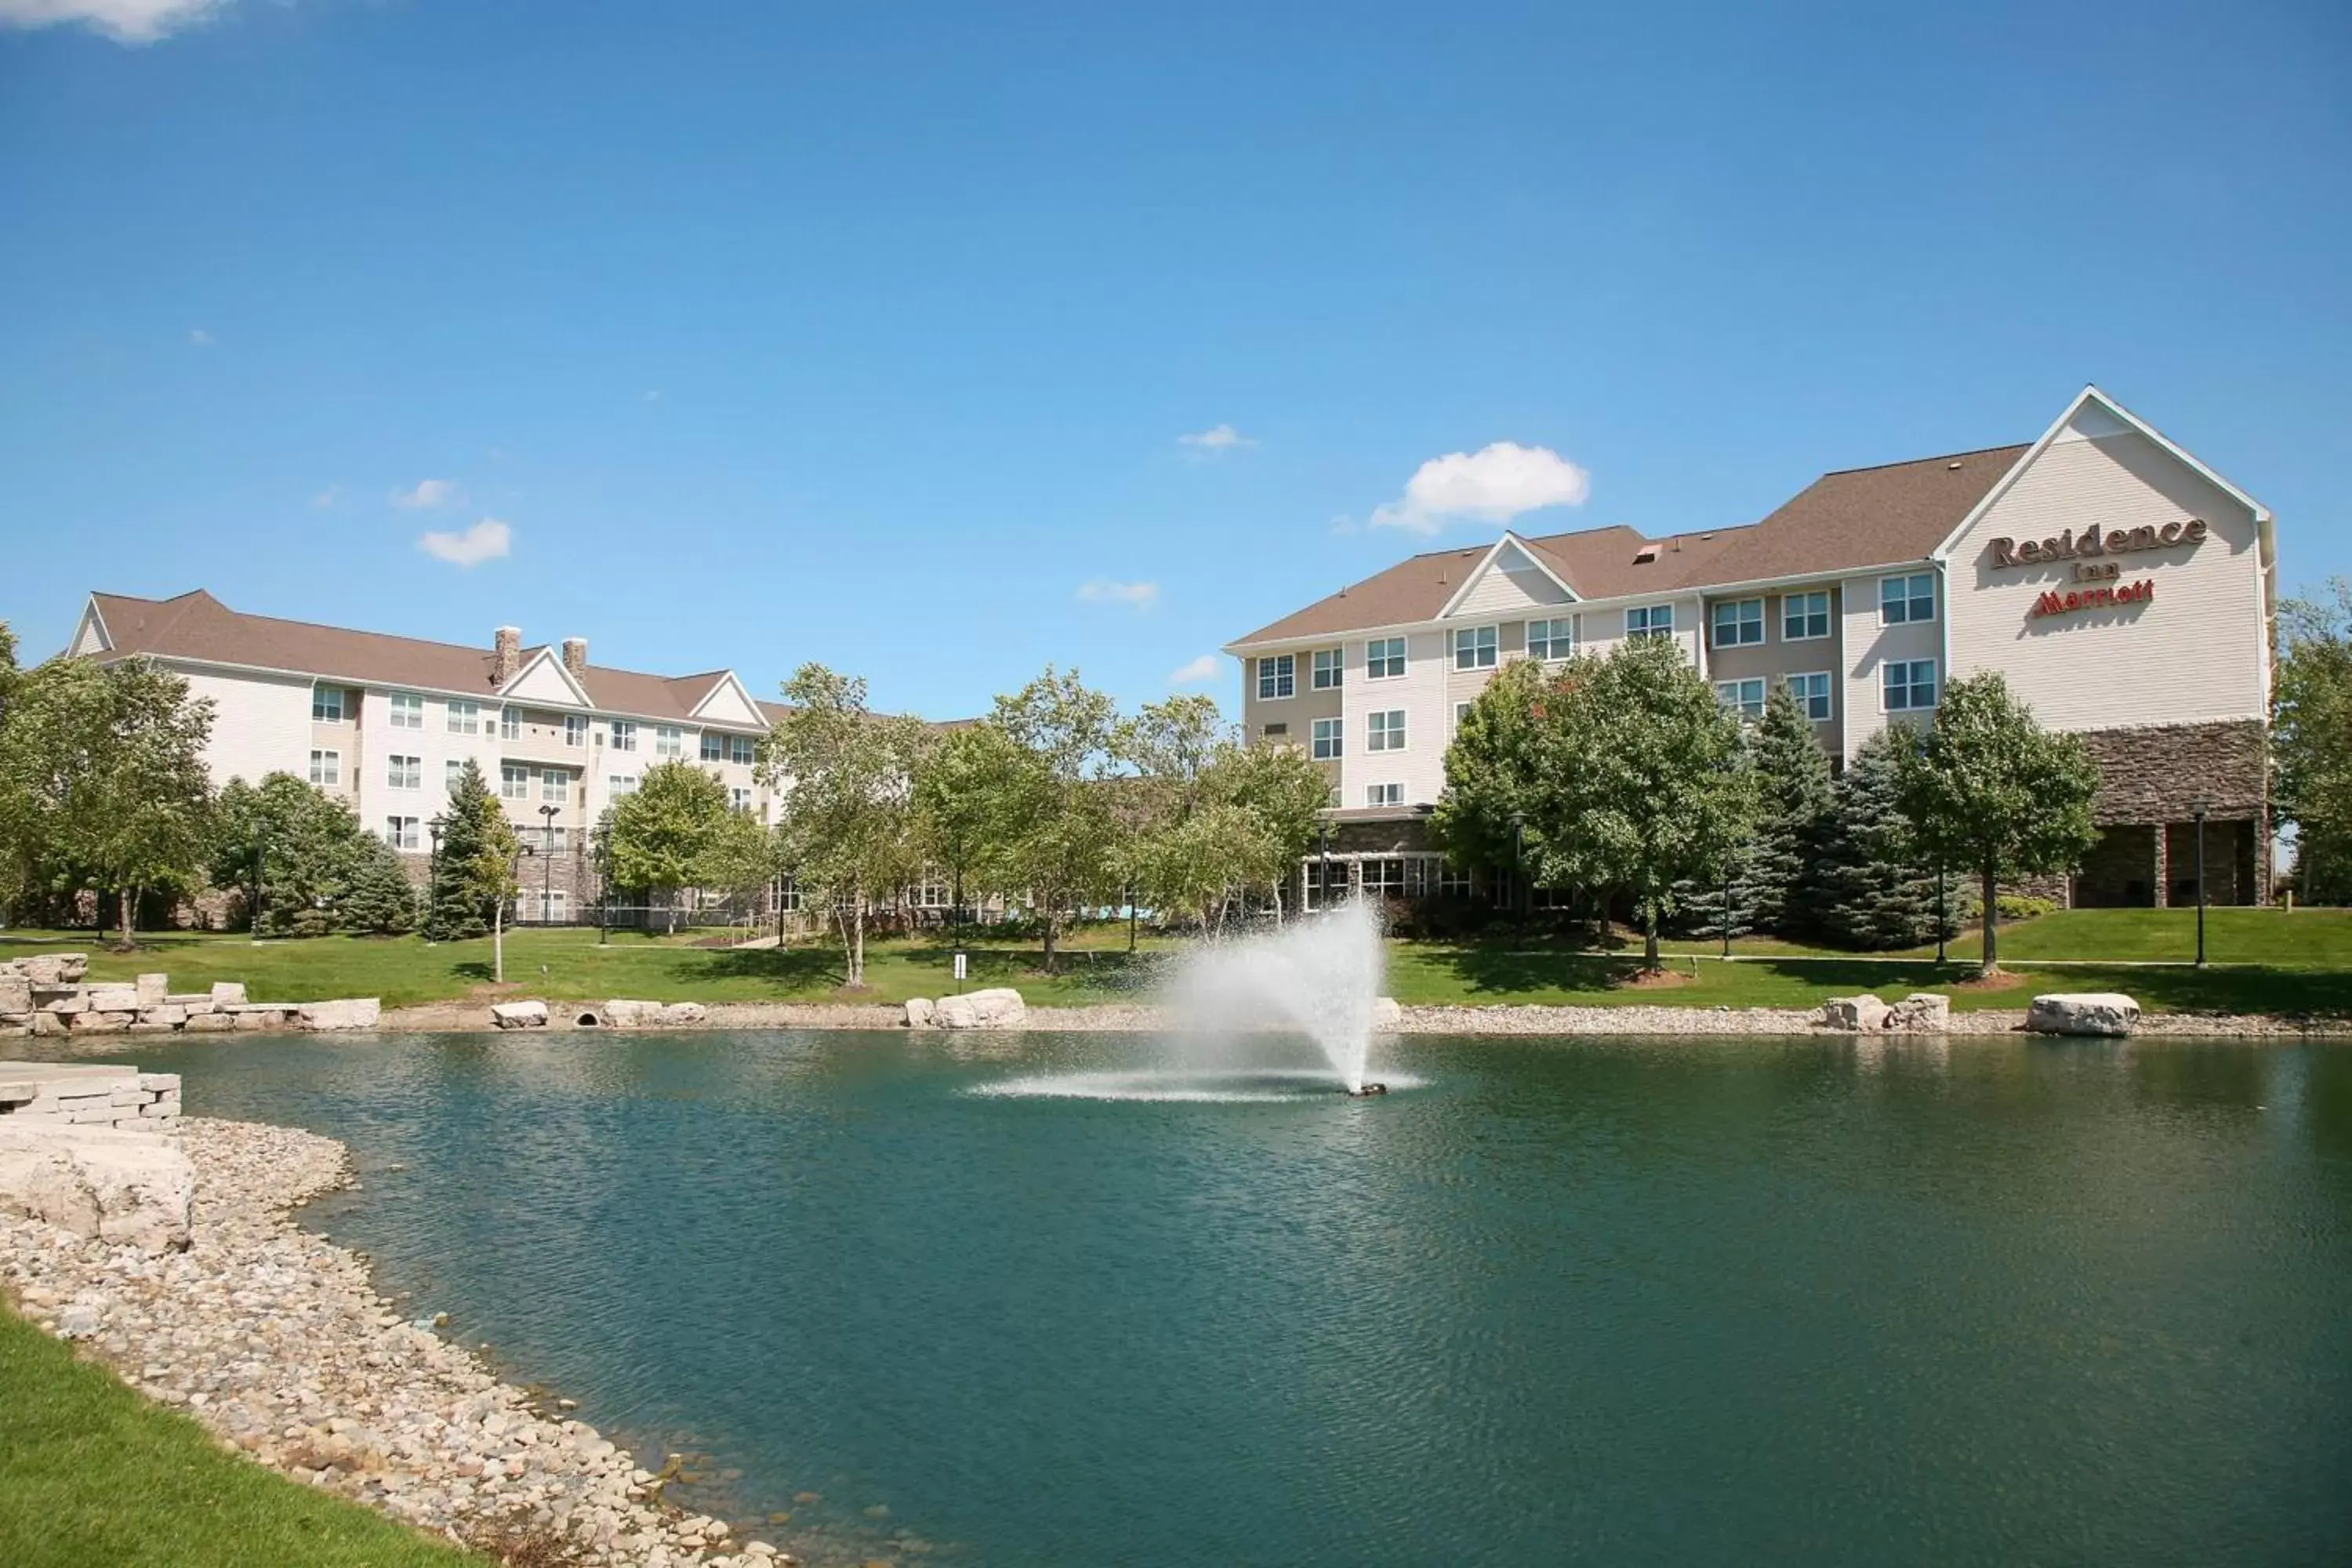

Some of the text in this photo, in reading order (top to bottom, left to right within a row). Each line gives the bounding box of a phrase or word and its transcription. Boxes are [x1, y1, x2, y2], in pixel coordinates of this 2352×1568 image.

[1988, 517, 2207, 569] Residence
[2070, 561, 2121, 583] Inn
[2032, 579, 2154, 619] Marriott
